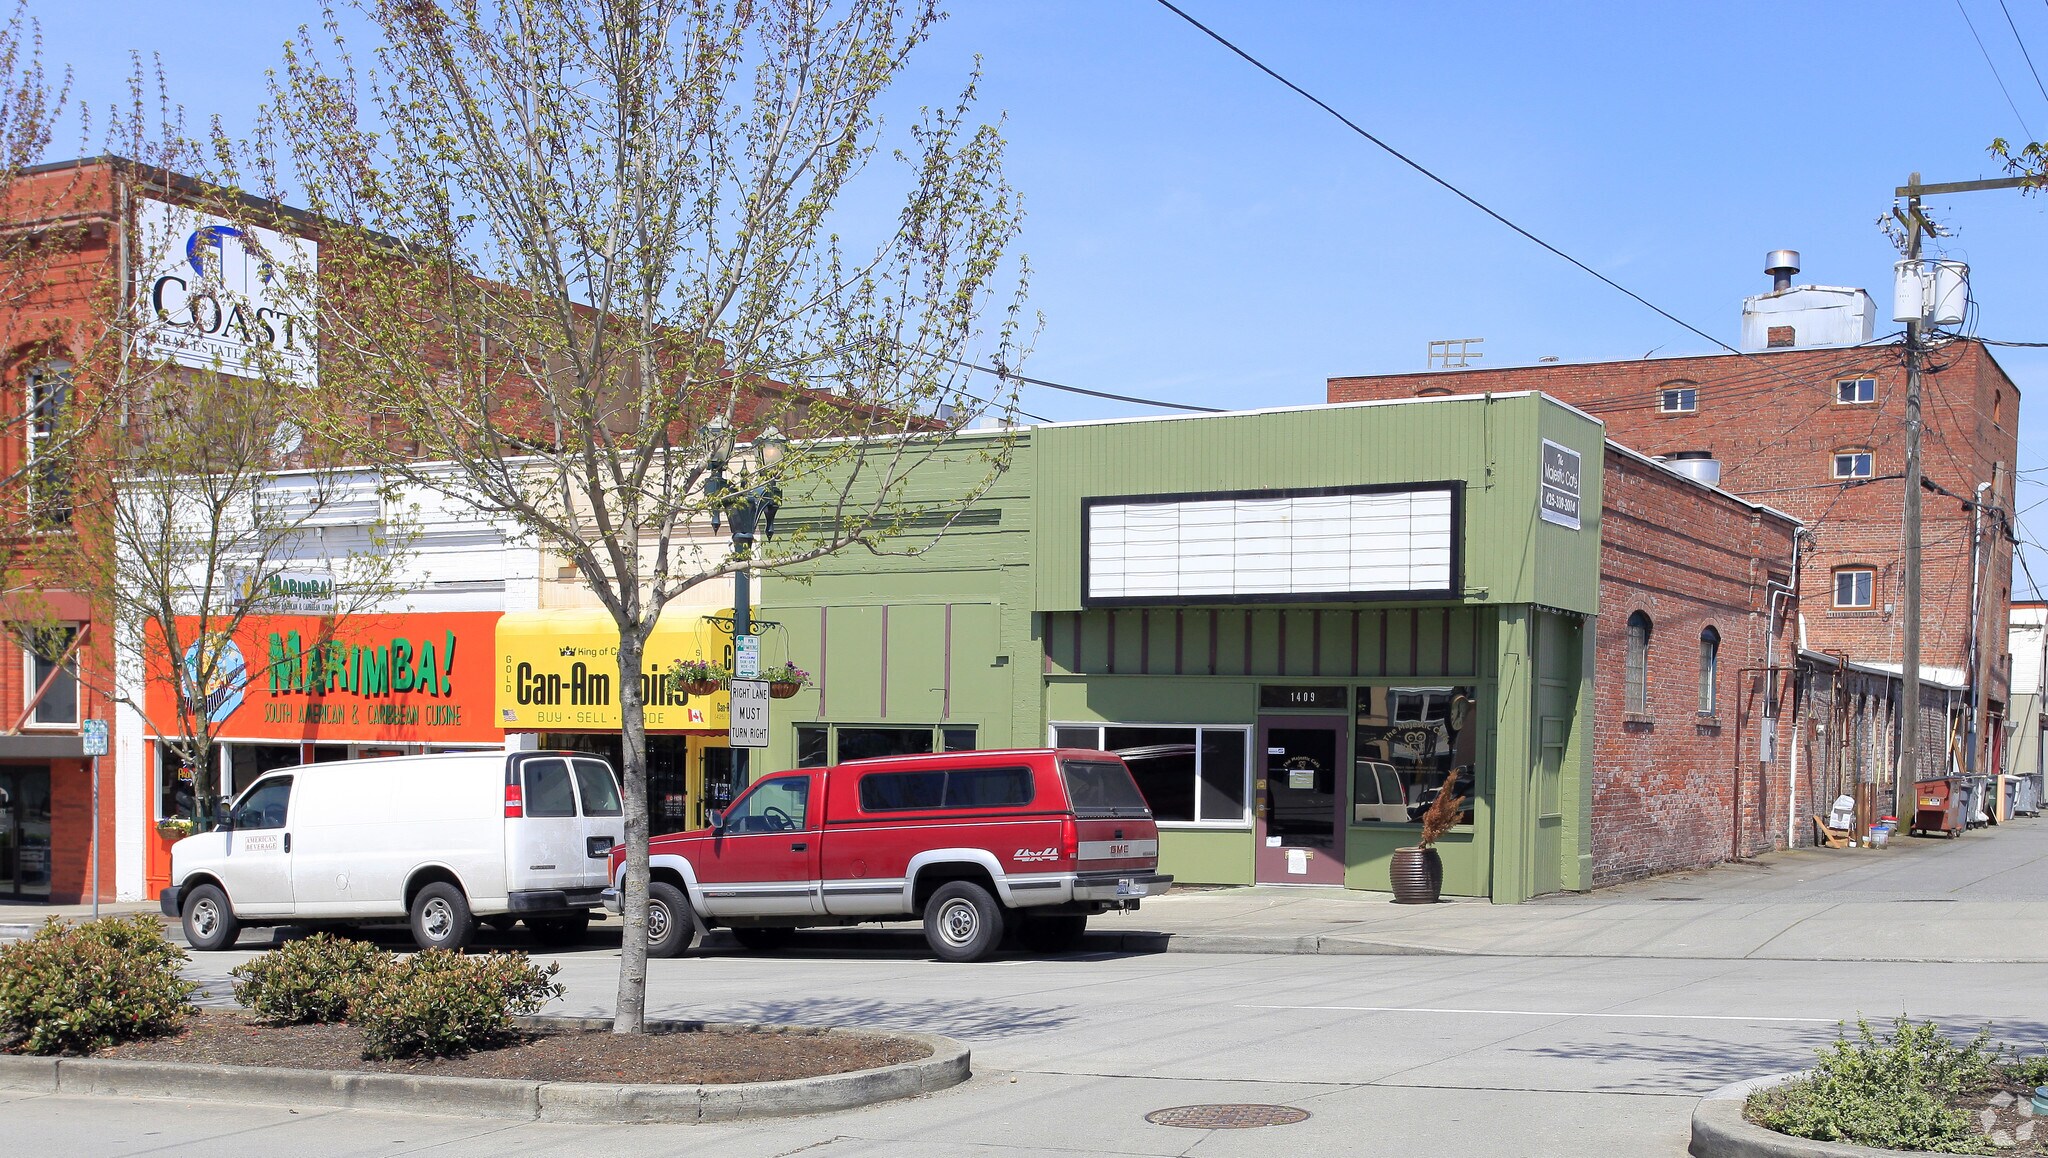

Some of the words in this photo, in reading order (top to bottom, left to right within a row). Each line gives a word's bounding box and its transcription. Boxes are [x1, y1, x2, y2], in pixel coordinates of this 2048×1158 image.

[153, 275, 303, 350] COAST
[193, 340, 242, 360] ESTATE
[268, 575, 333, 600] MARIMBA!
[577, 647, 597, 658] King
[598, 647, 609, 656] of
[268, 629, 457, 699] MARIMBA!
[517, 661, 610, 706] Can-Am
[641, 664, 690, 707] oins
[733, 687, 750, 699] RIGHT
[752, 689, 767, 700] LANE
[1291, 691, 1315, 702] 1409
[264, 703, 293, 724] SOUTH
[298, 704, 345, 725] AMERICAN
[351, 704, 359, 725] &
[368, 704, 419, 726] CARIBBEAN
[425, 704, 462, 726] CUISINE
[537, 711, 562, 723] BUY
[577, 711, 607, 723] SELL
[739, 707, 761, 720] MUST
[732, 727, 748, 738] TURN
[750, 728, 767, 739] RIGHT
[1383, 728, 1398, 741] The
[1397, 722, 1432, 731] Majestic
[1013, 847, 1059, 862] 4x4
